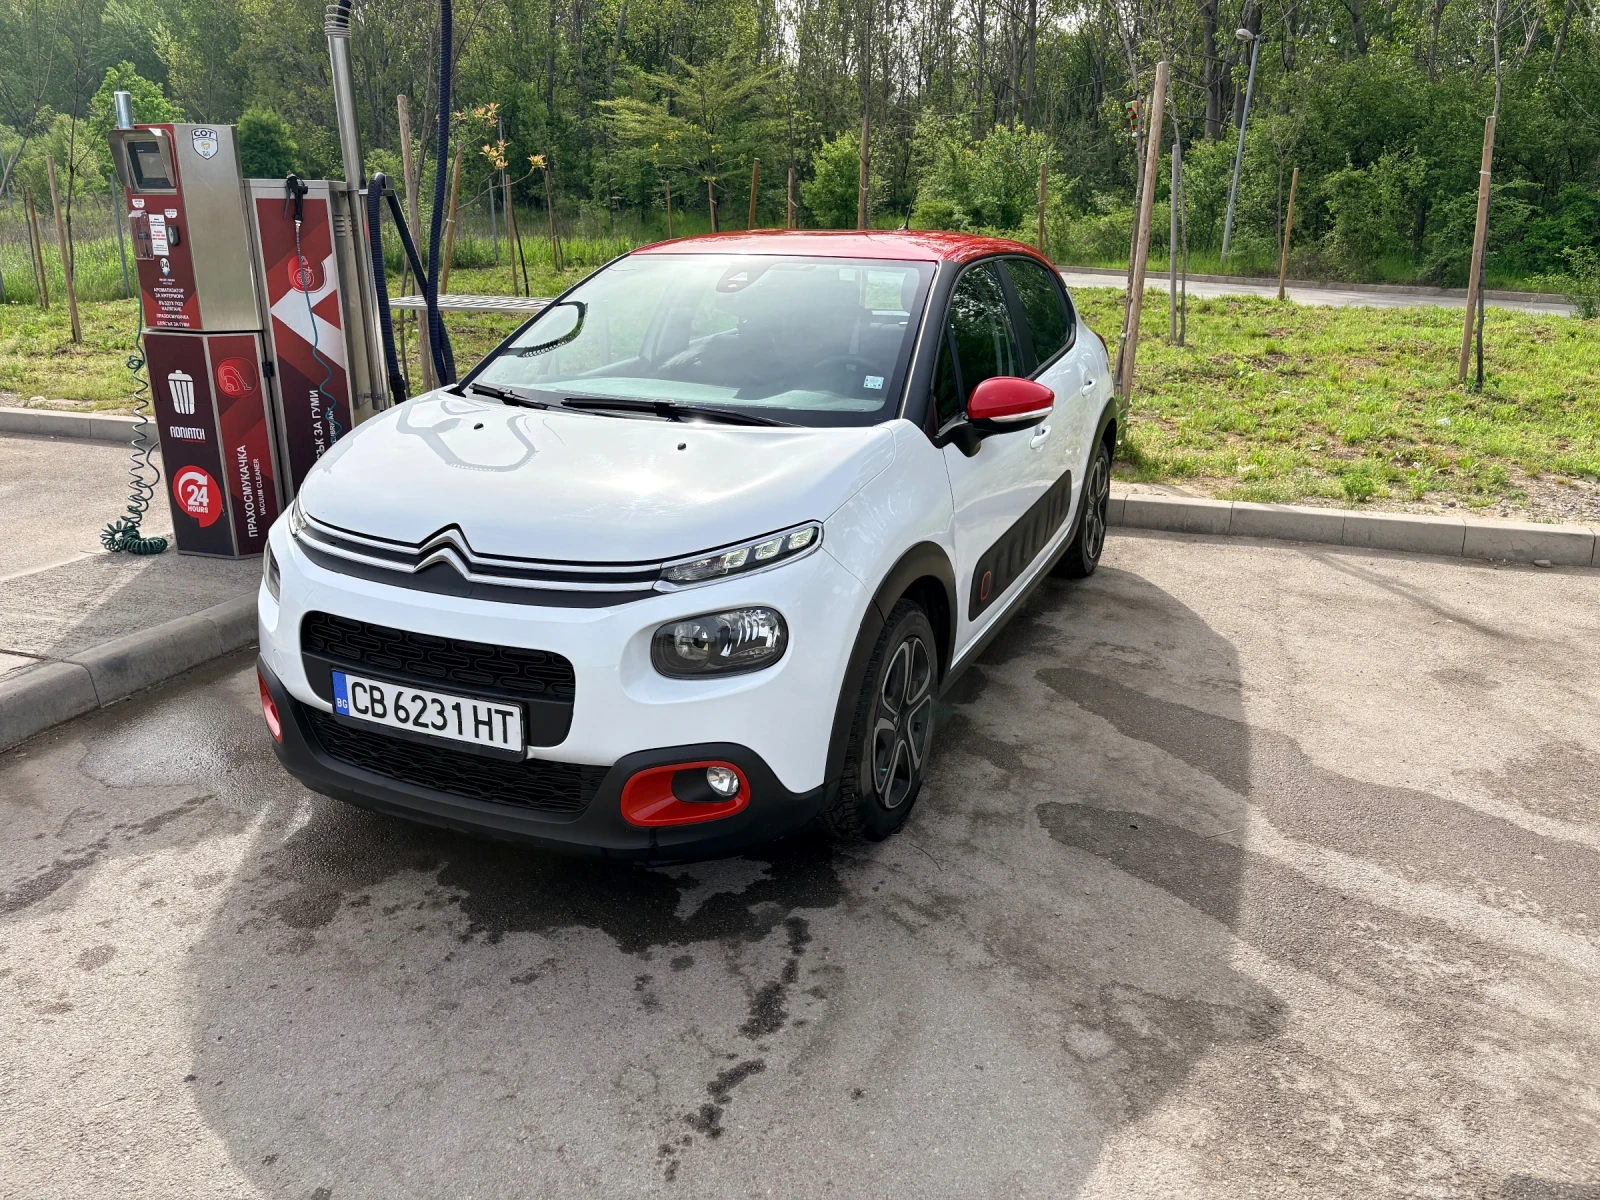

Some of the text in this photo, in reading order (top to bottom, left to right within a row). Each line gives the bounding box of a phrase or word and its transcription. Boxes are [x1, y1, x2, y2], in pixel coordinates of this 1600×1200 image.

[309, 390, 321, 418] ГУМИ
[313, 421, 323, 435] ЗА
[187, 485, 209, 506] 24
[237, 445, 259, 538] ПРАХОСМУКАЧКА
[253, 458, 266, 516] VACUUM CLEANER
[337, 698, 348, 709] BG
